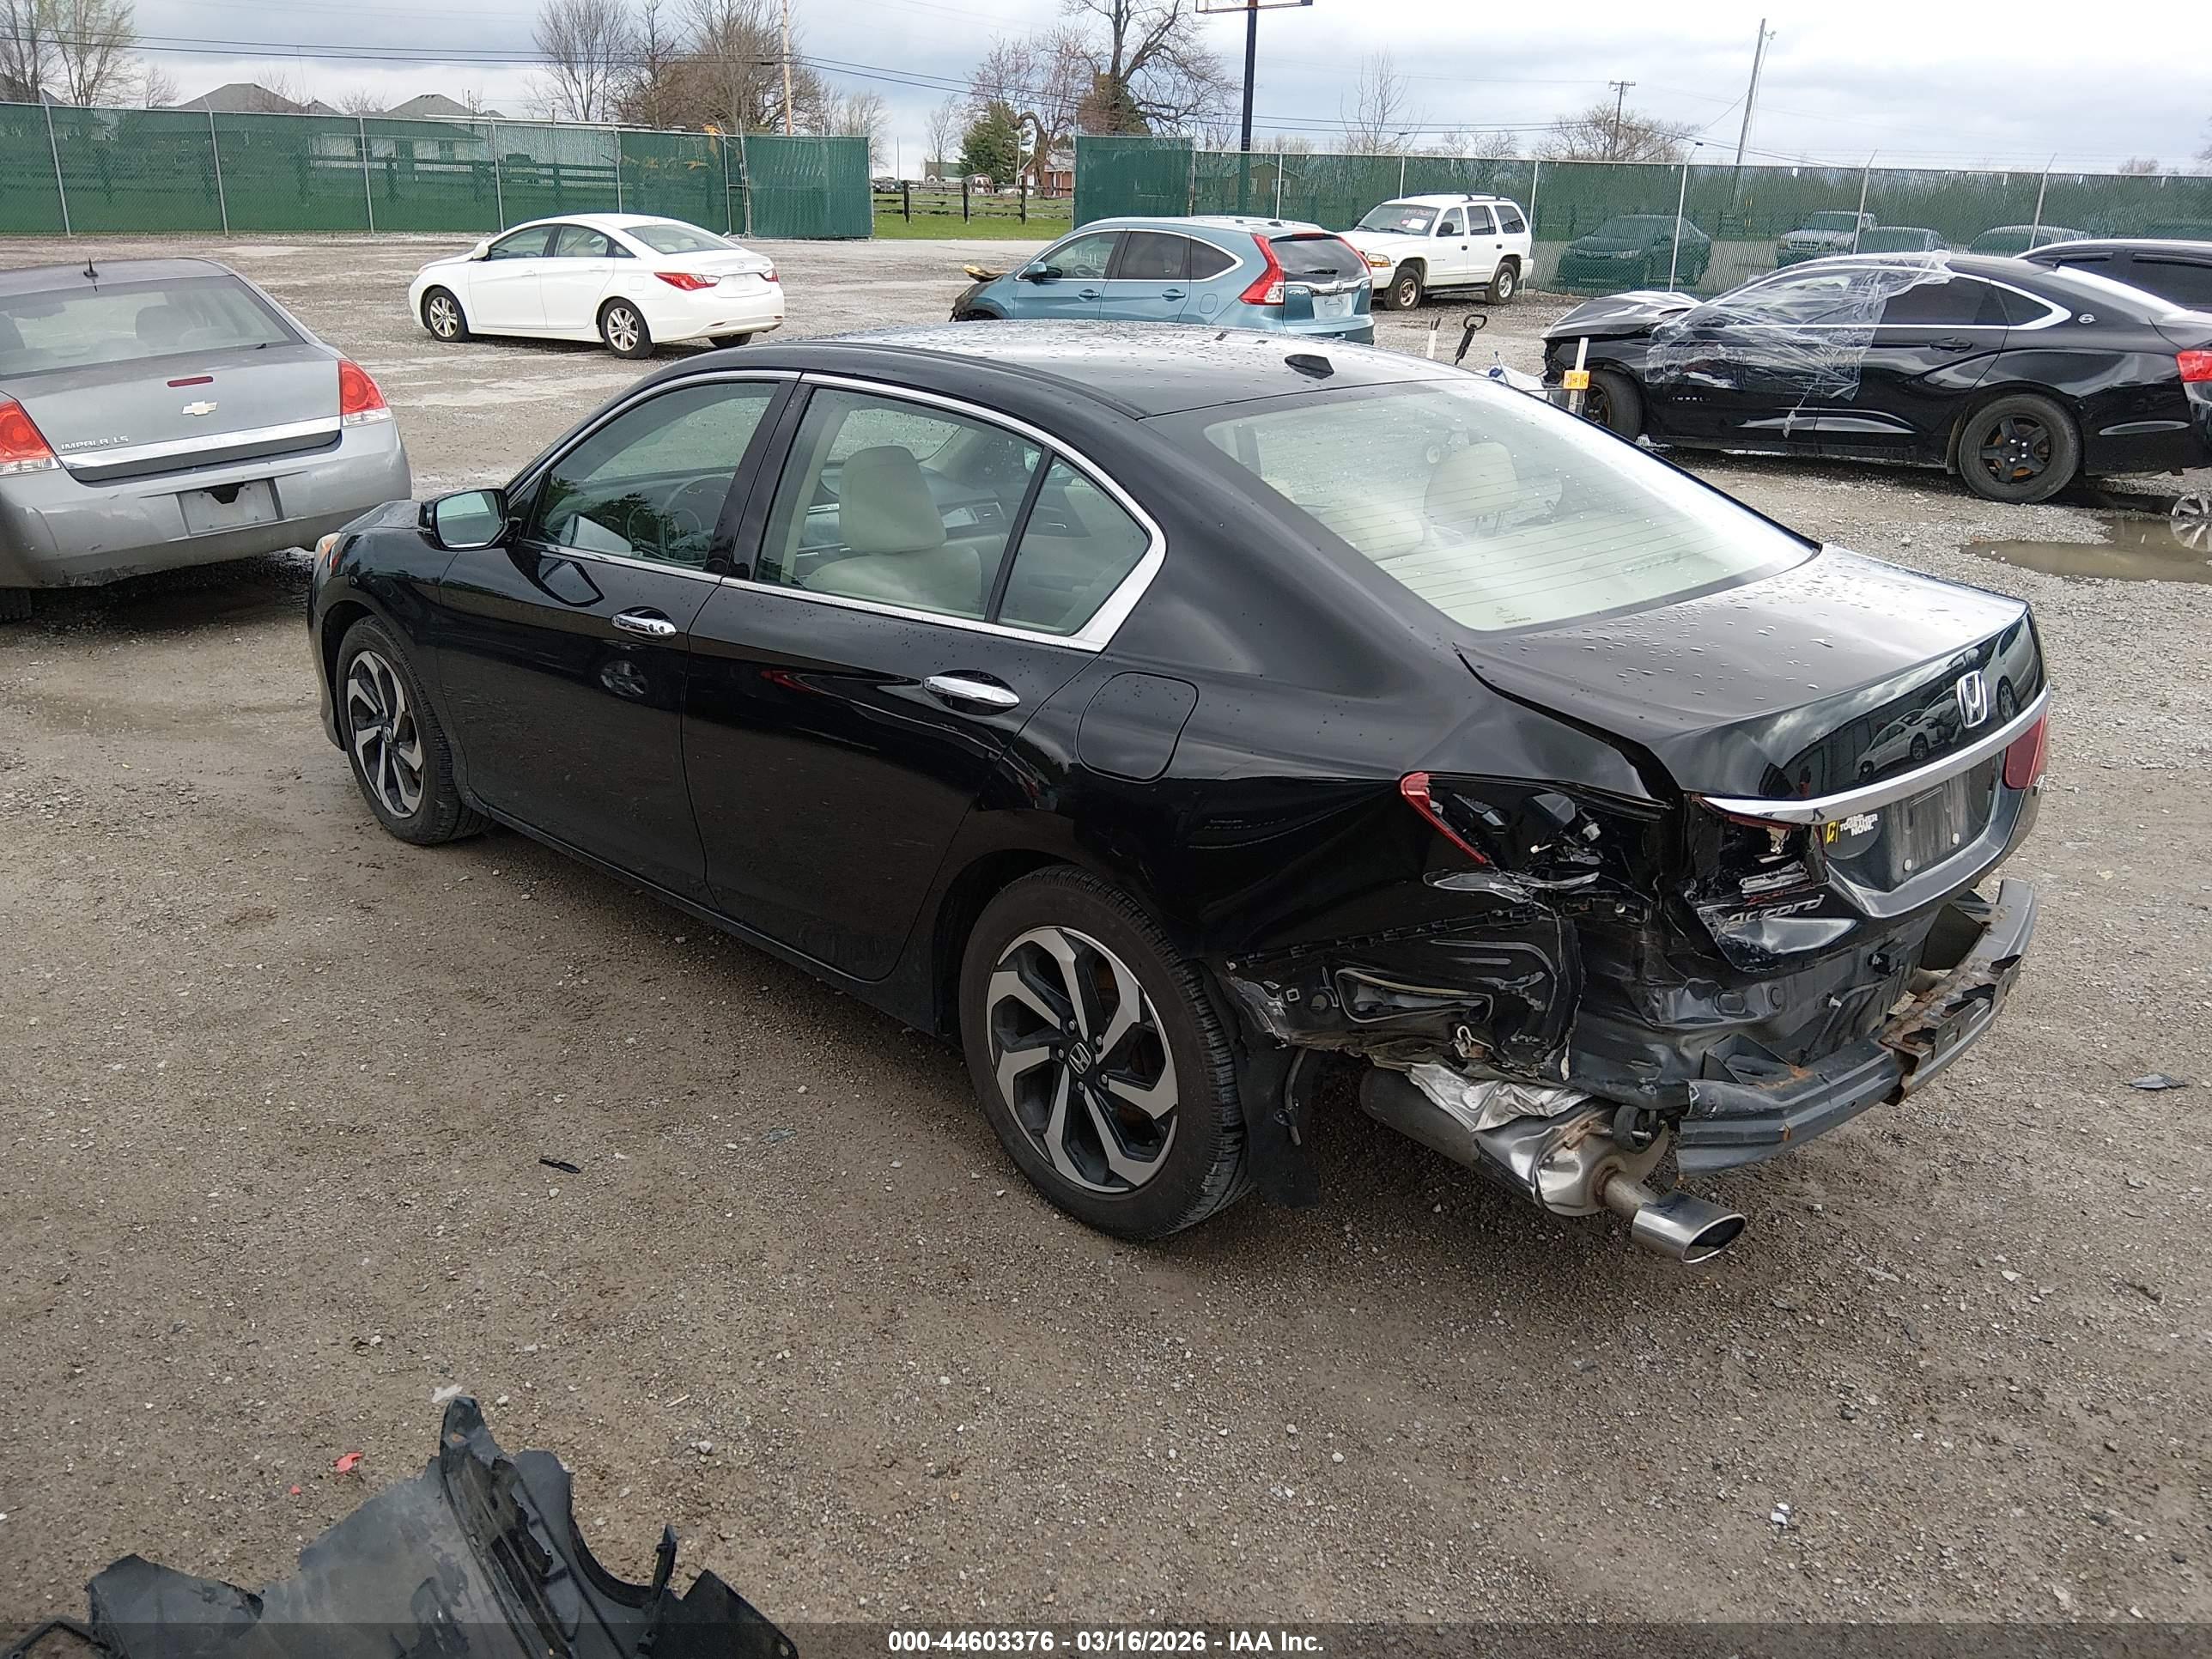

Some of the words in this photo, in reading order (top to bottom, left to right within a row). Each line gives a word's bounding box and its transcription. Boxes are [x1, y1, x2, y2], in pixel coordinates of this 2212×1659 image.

[61, 438, 110, 451] IMPALA
[113, 435, 130, 444] LS
[1839, 813, 1878, 832] TOGETHER
